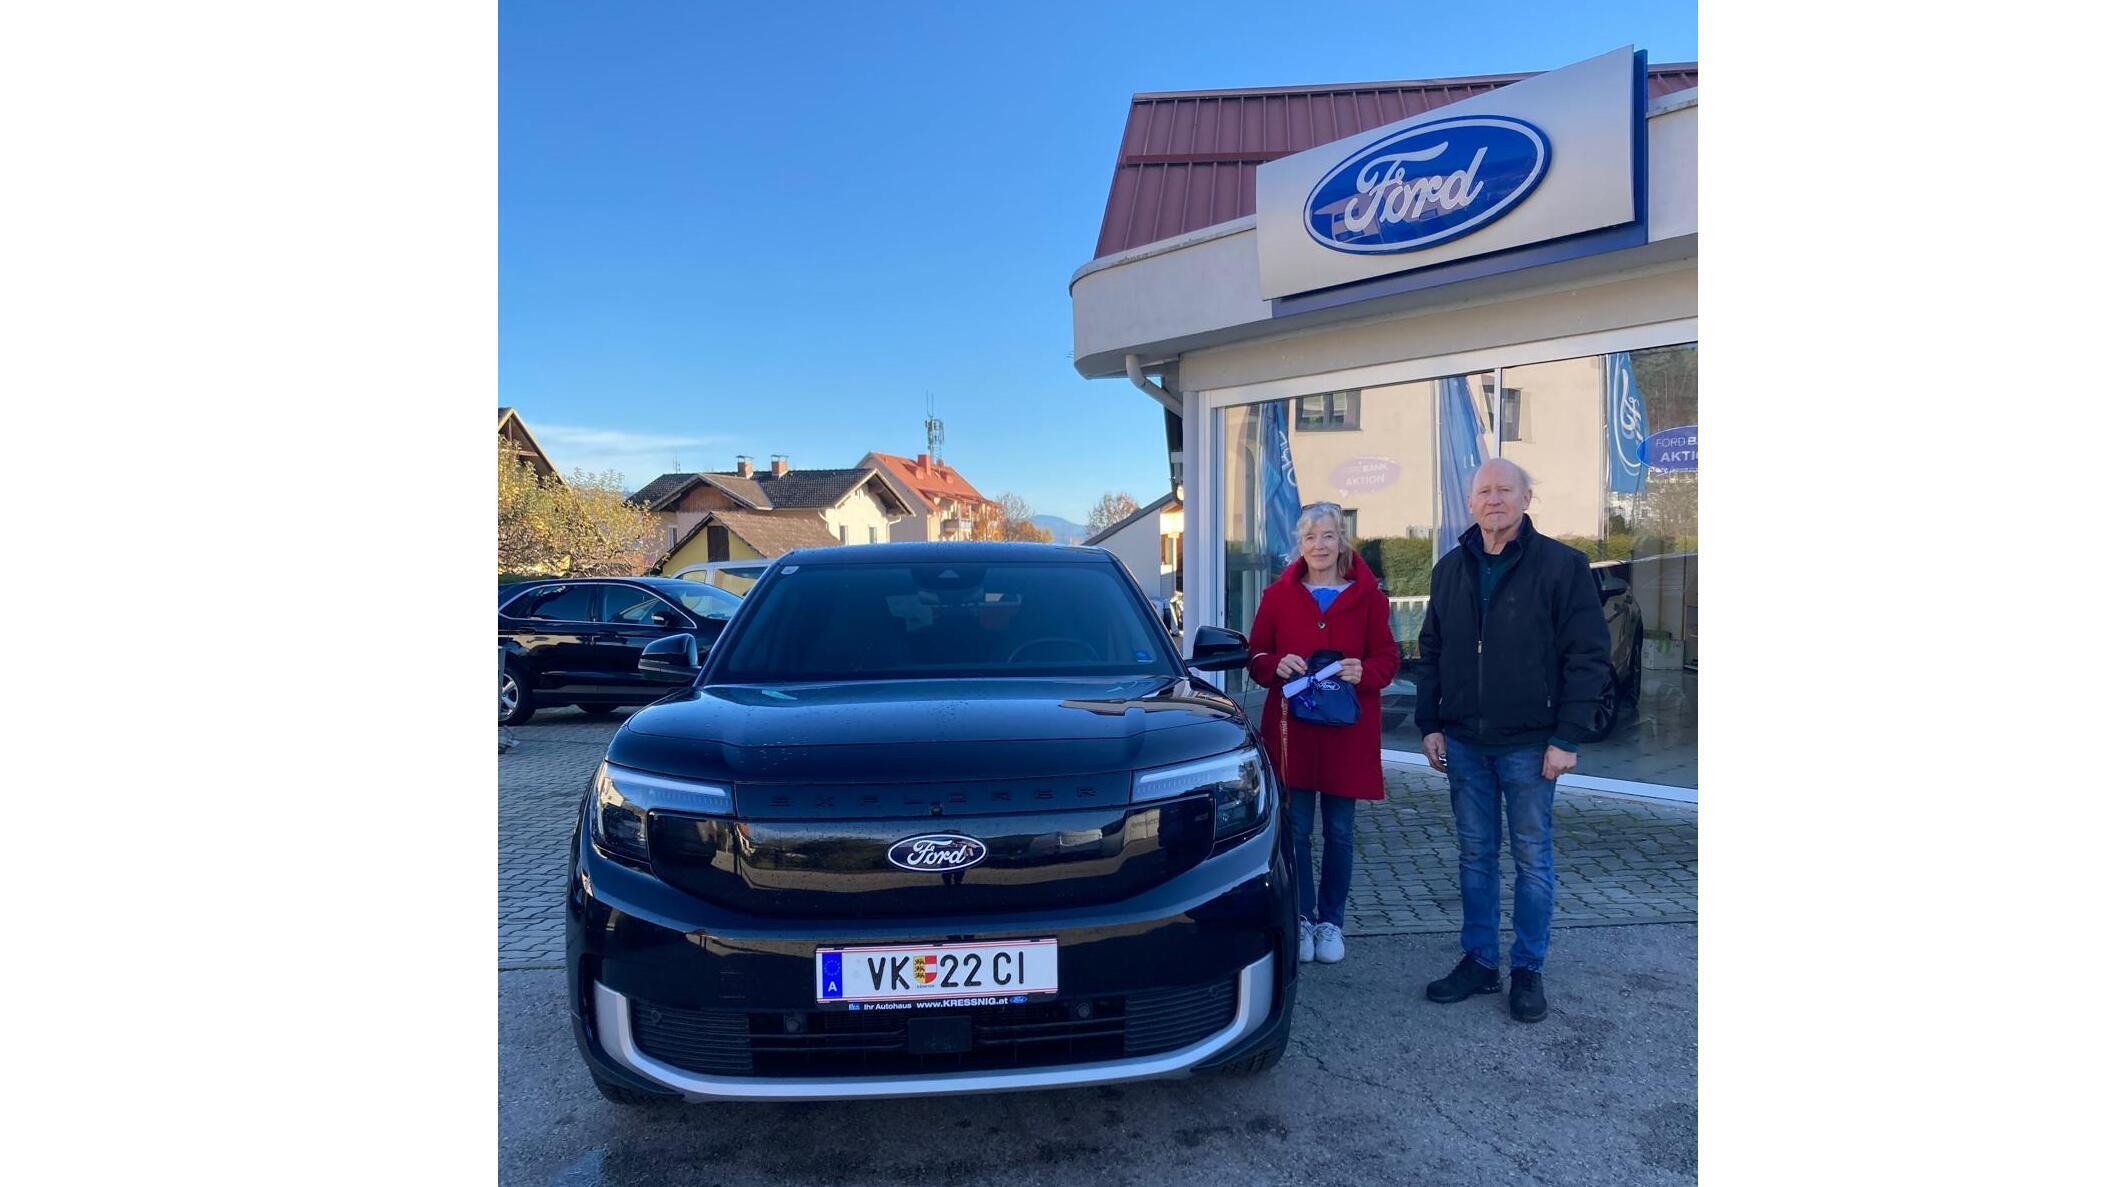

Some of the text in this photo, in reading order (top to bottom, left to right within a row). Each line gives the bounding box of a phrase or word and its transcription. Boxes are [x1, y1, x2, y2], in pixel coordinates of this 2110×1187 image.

[1344, 141, 1488, 233] Ford
[1656, 437, 1686, 447] FORD
[1661, 450, 1698, 462] AKTI
[1345, 474, 1385, 487] AKTION
[907, 840, 967, 866] Ford
[867, 951, 1024, 991] VK 22 CI
[828, 981, 838, 992] A
[863, 1003, 874, 1011] Ihr
[875, 1002, 912, 1010] Autohaus
[916, 997, 1009, 1009] www.KRESSNIG.at
